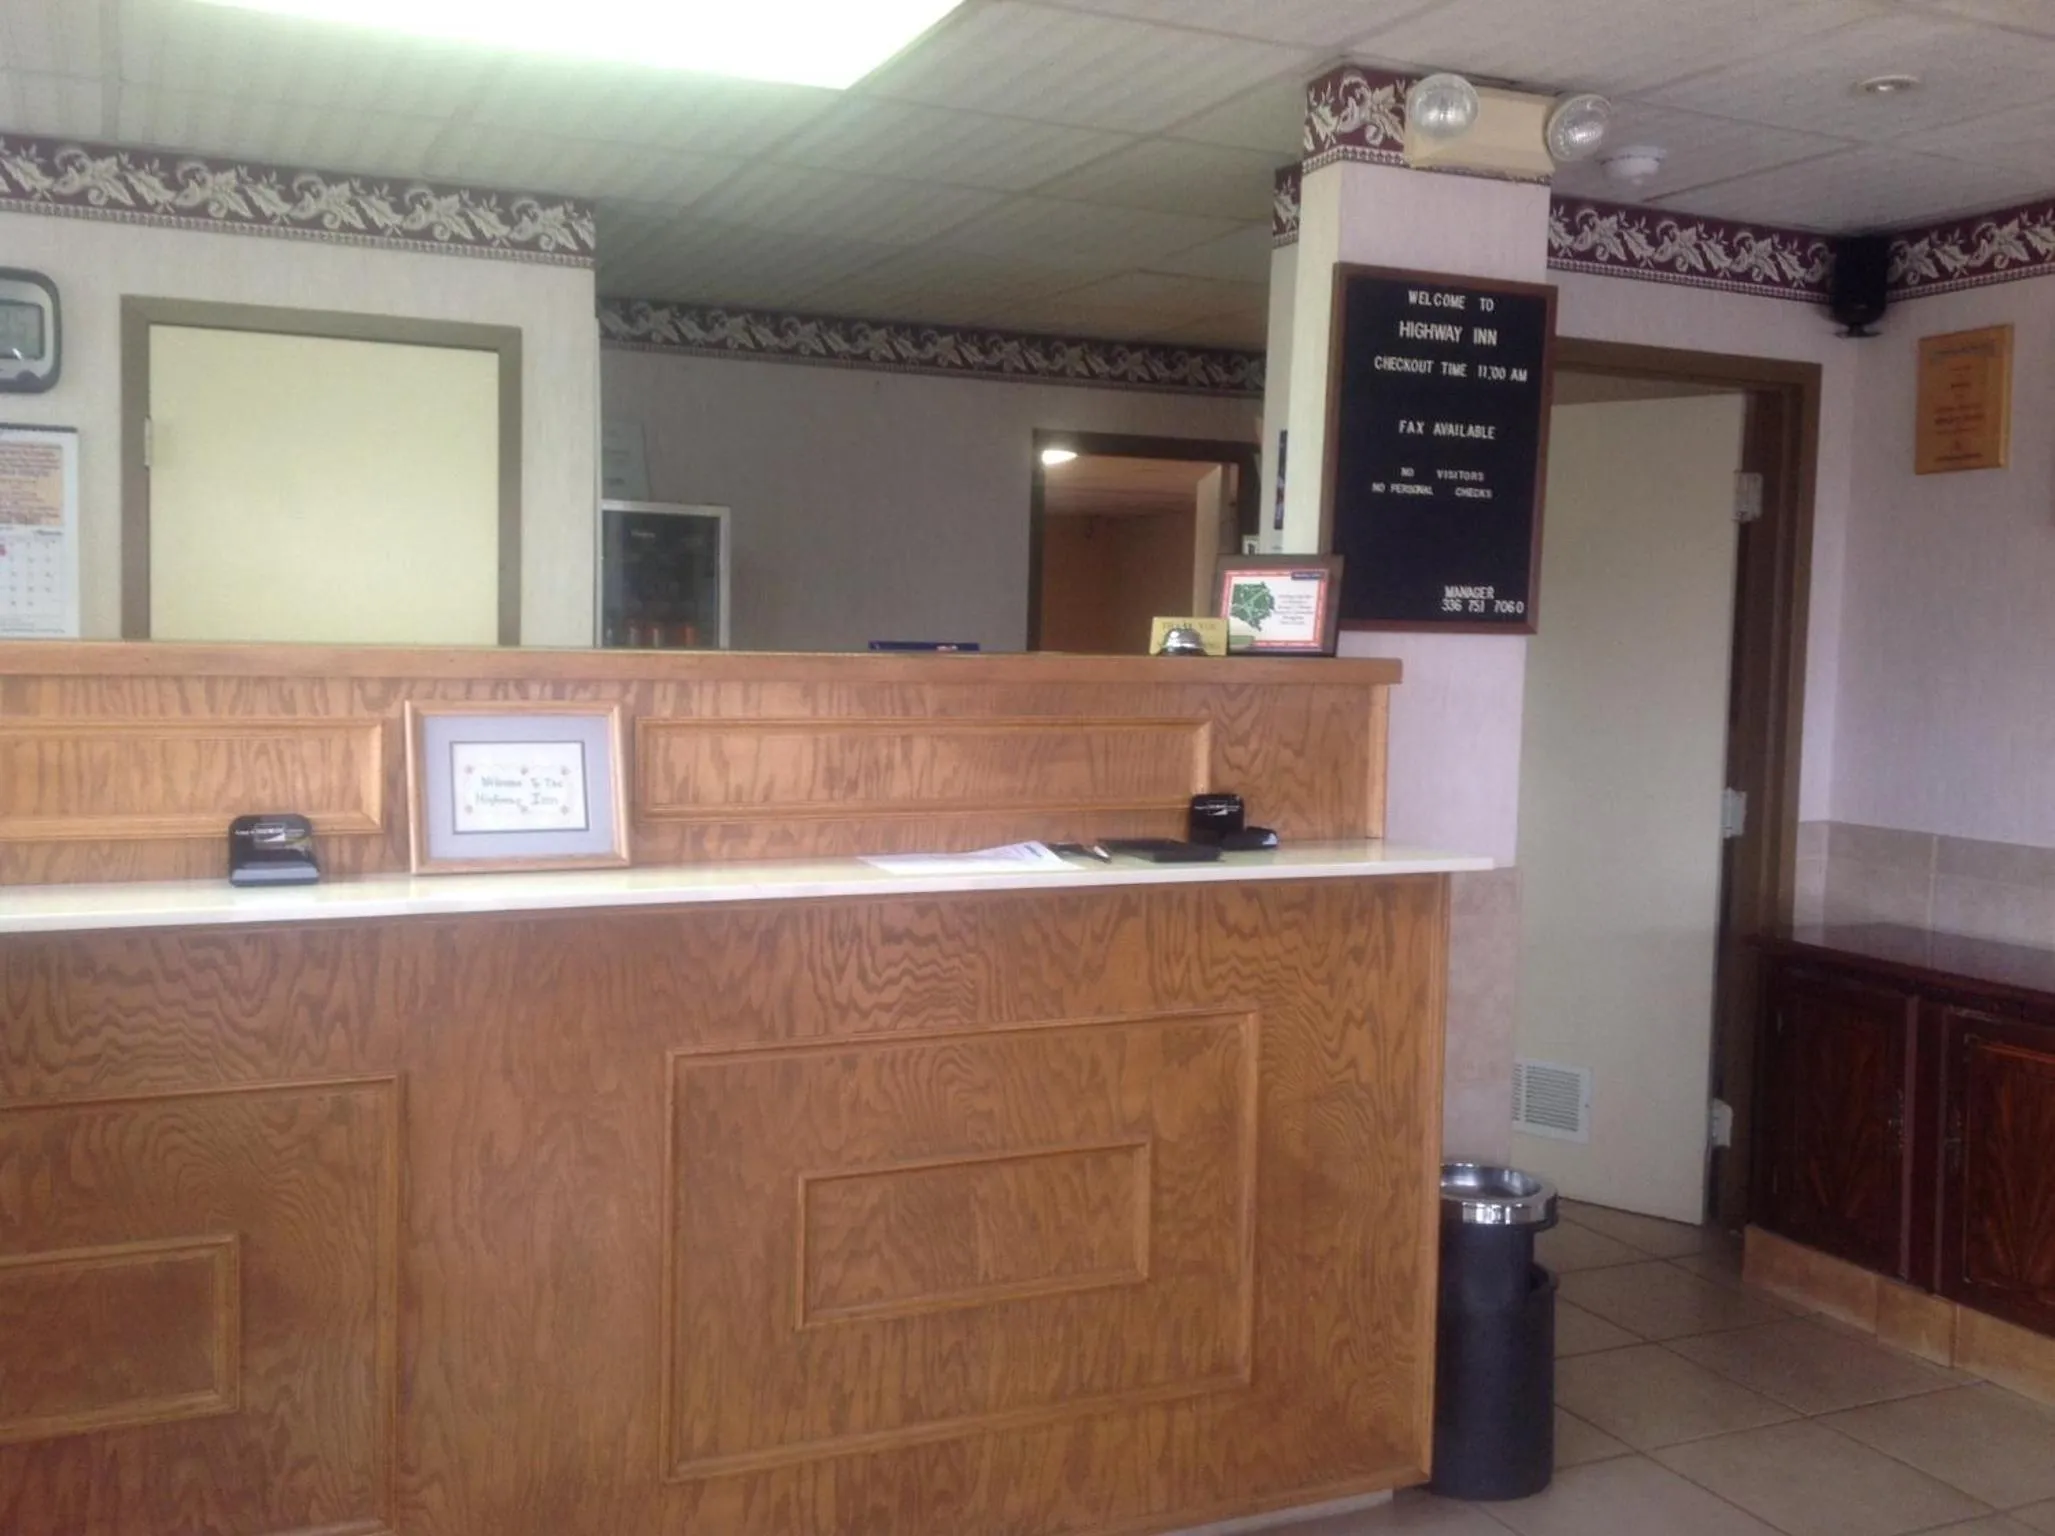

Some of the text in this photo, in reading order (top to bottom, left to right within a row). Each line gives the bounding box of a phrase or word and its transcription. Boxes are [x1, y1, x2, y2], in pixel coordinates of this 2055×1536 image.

[1408, 290, 1495, 312] WELCOME TO
[1399, 320, 1498, 346] HIGHWAY INN
[1374, 356, 1434, 374] CHECKOUT
[1441, 361, 1467, 377] TIME
[1510, 367, 1528, 382] AM
[1399, 420, 1496, 439] FAX AVAILABLE
[1401, 467, 1484, 482] NO VISITORS
[1372, 482, 1493, 499] NO PERSONAL CHECKS
[1444, 585, 1494, 599] MANAGER
[1494, 599, 1525, 614] 7060
